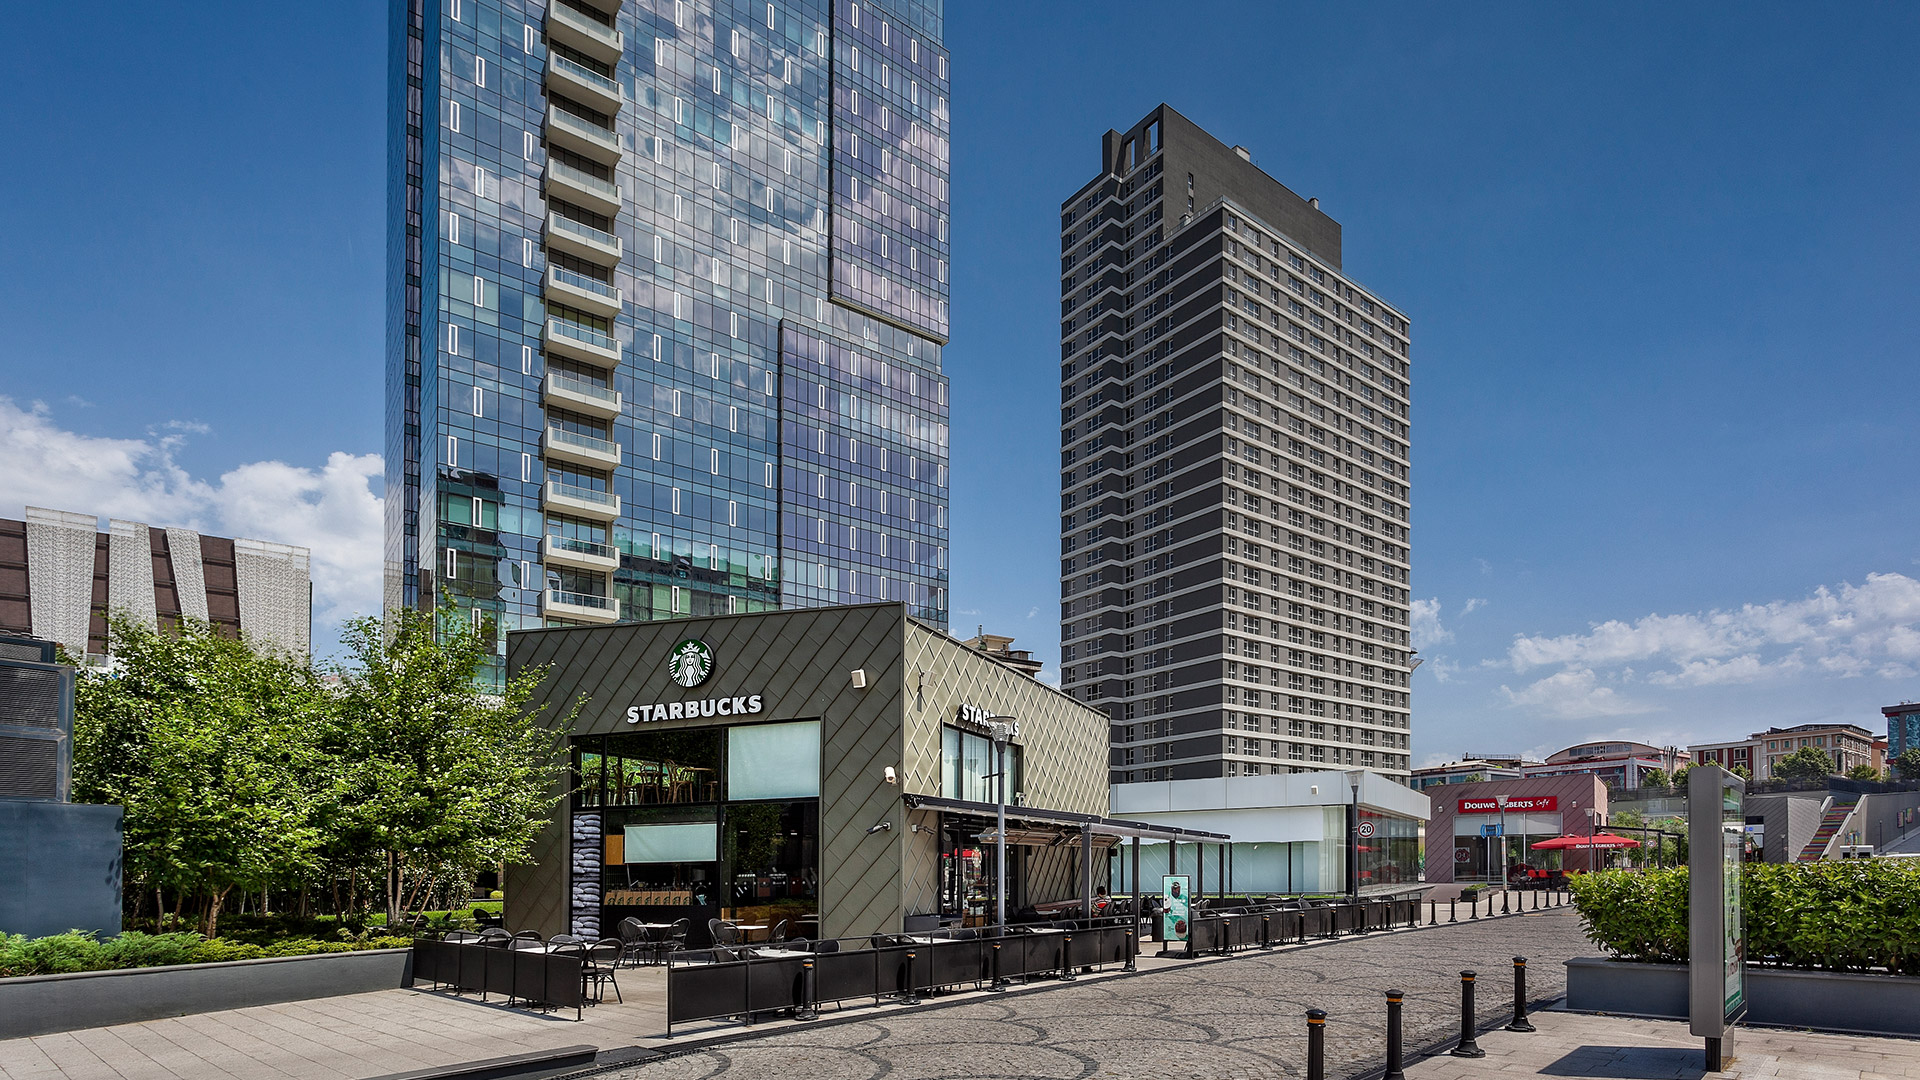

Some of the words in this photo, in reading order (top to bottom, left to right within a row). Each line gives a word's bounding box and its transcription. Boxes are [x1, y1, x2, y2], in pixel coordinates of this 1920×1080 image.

[627, 695, 762, 724] STARBUCKS
[962, 703, 1020, 737] STARS
[1498, 800, 1534, 809] GBERTS
[1361, 825, 1372, 834] 20
